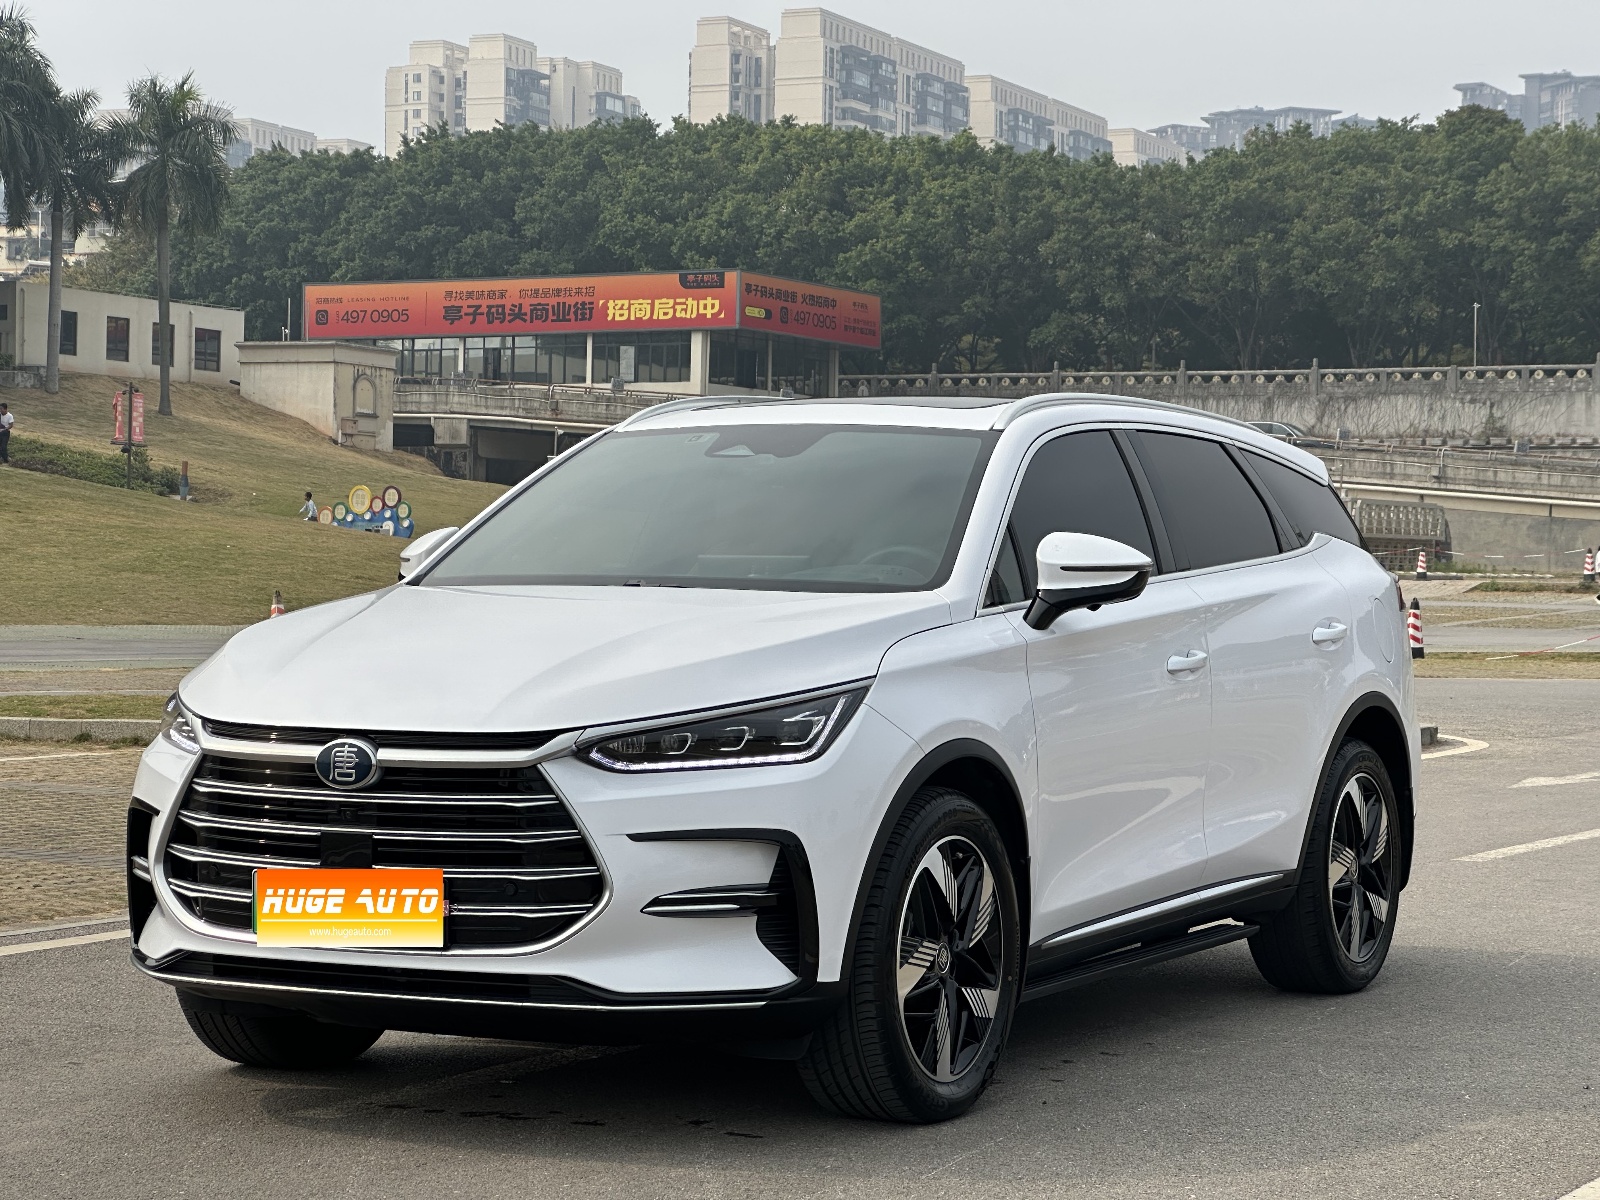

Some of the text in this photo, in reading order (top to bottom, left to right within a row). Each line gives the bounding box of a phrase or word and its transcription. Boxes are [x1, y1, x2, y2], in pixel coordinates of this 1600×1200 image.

[744, 282, 798, 303] 亭子码头商业街
[443, 301, 595, 325] 亭子码头商业街
[328, 744, 360, 782] 唐
